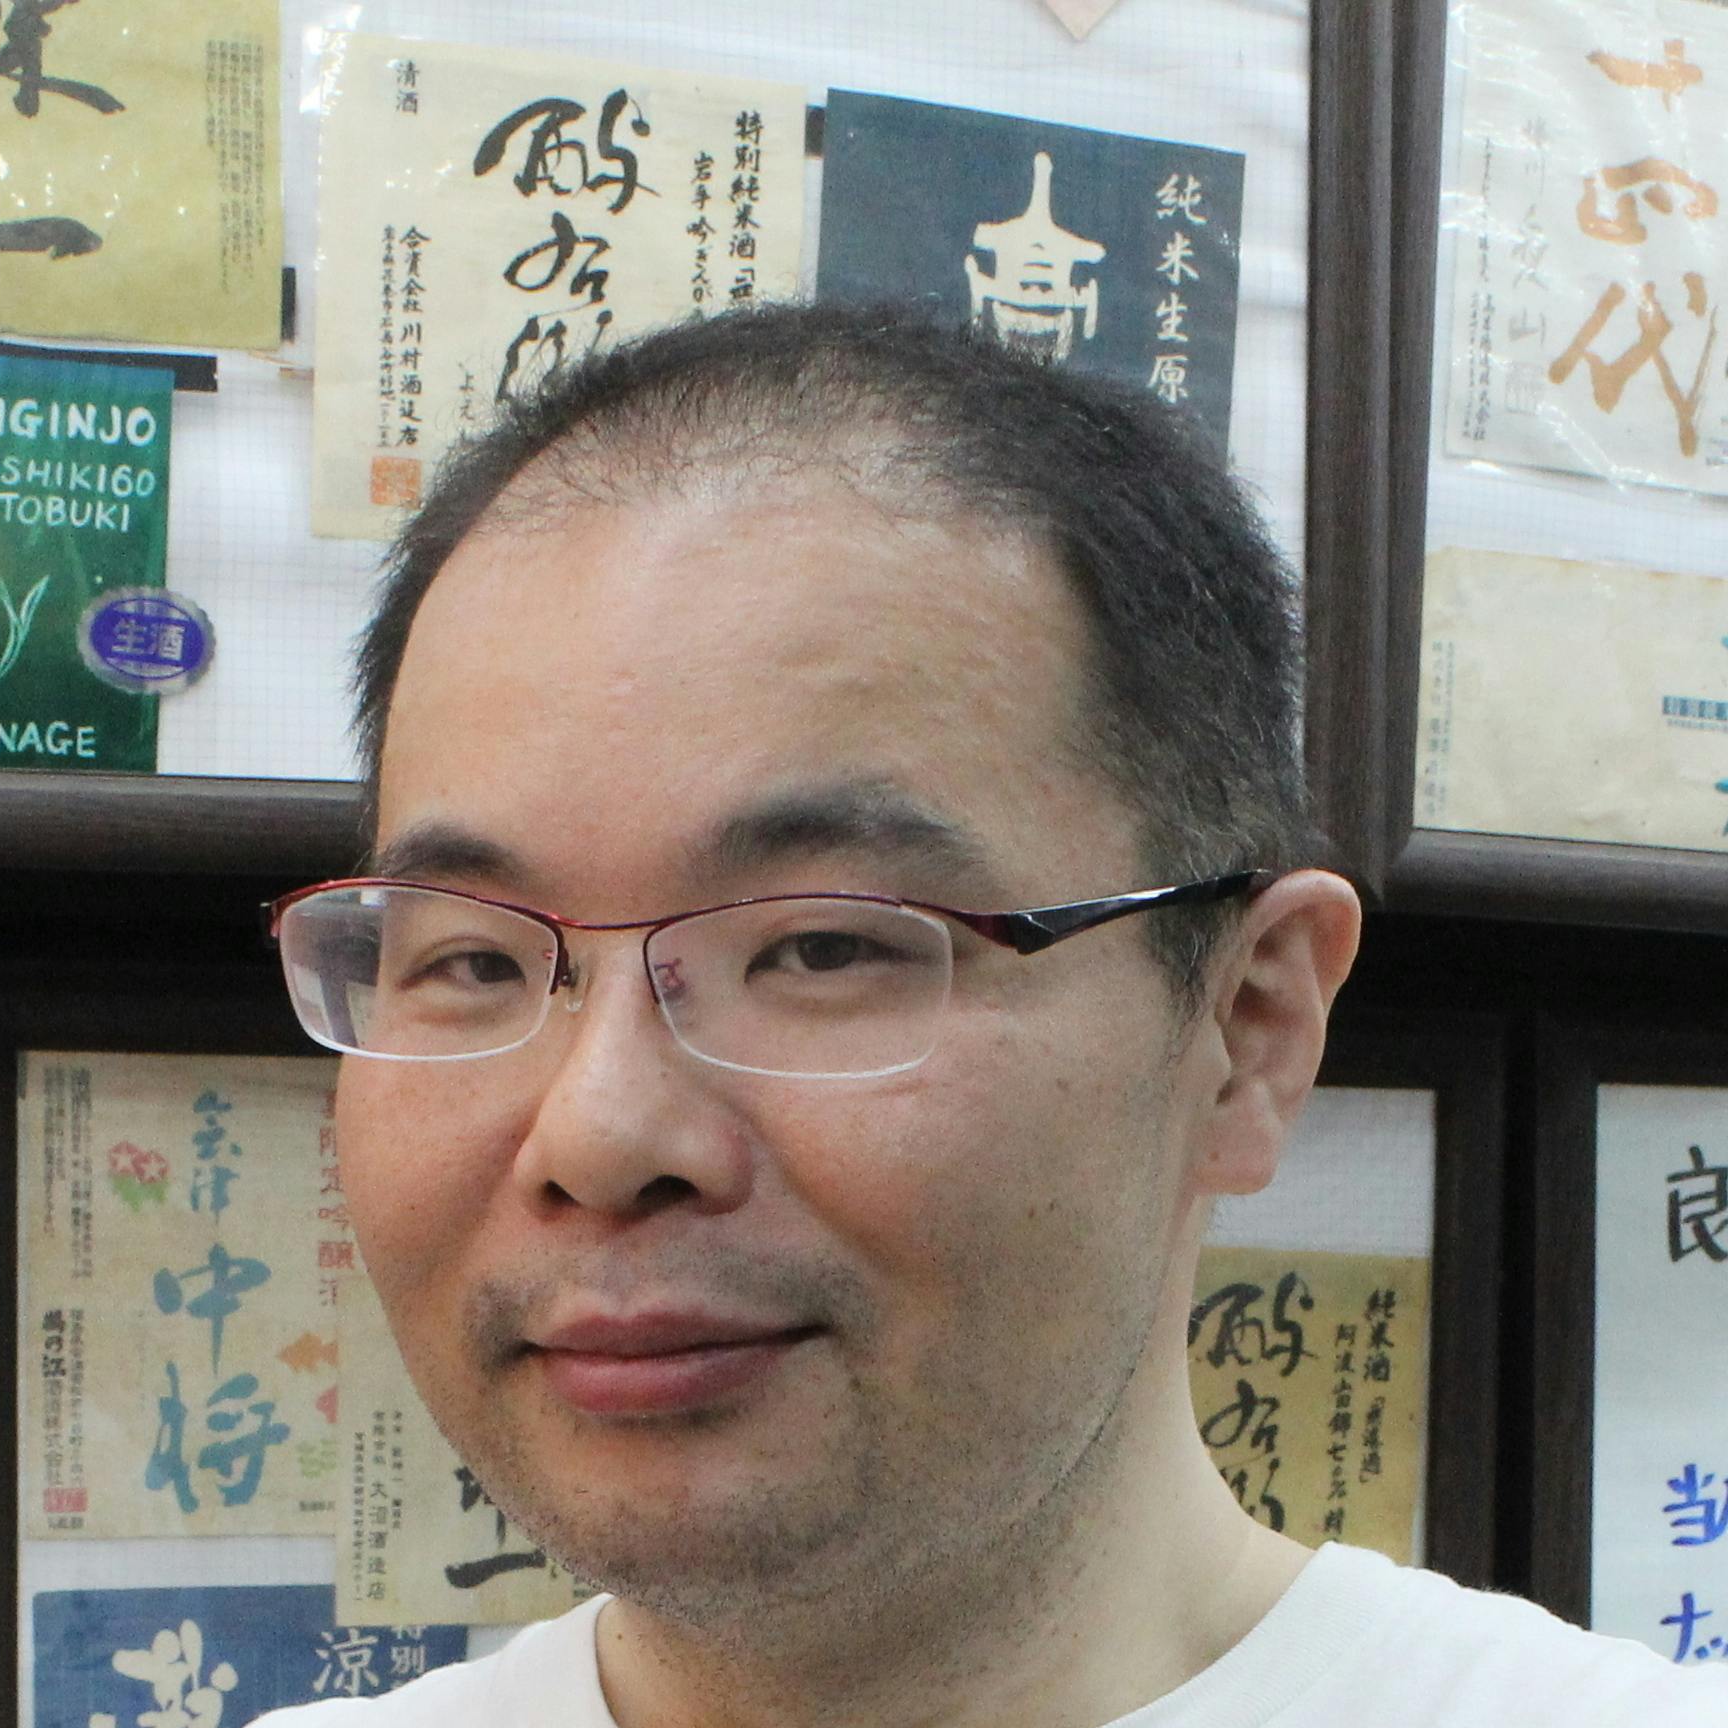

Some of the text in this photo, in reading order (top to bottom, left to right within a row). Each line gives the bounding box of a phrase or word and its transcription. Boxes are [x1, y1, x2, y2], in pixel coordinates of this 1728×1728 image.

[395, 59, 420, 115] 清酒
[1548, 38, 1720, 459] 十四代
[396, 321, 424, 448] 川村酒造店
[110, 618, 186, 663] 生酒
[1364, 1287, 1396, 1382] 純米酒
[313, 1628, 381, 1696] 涼
